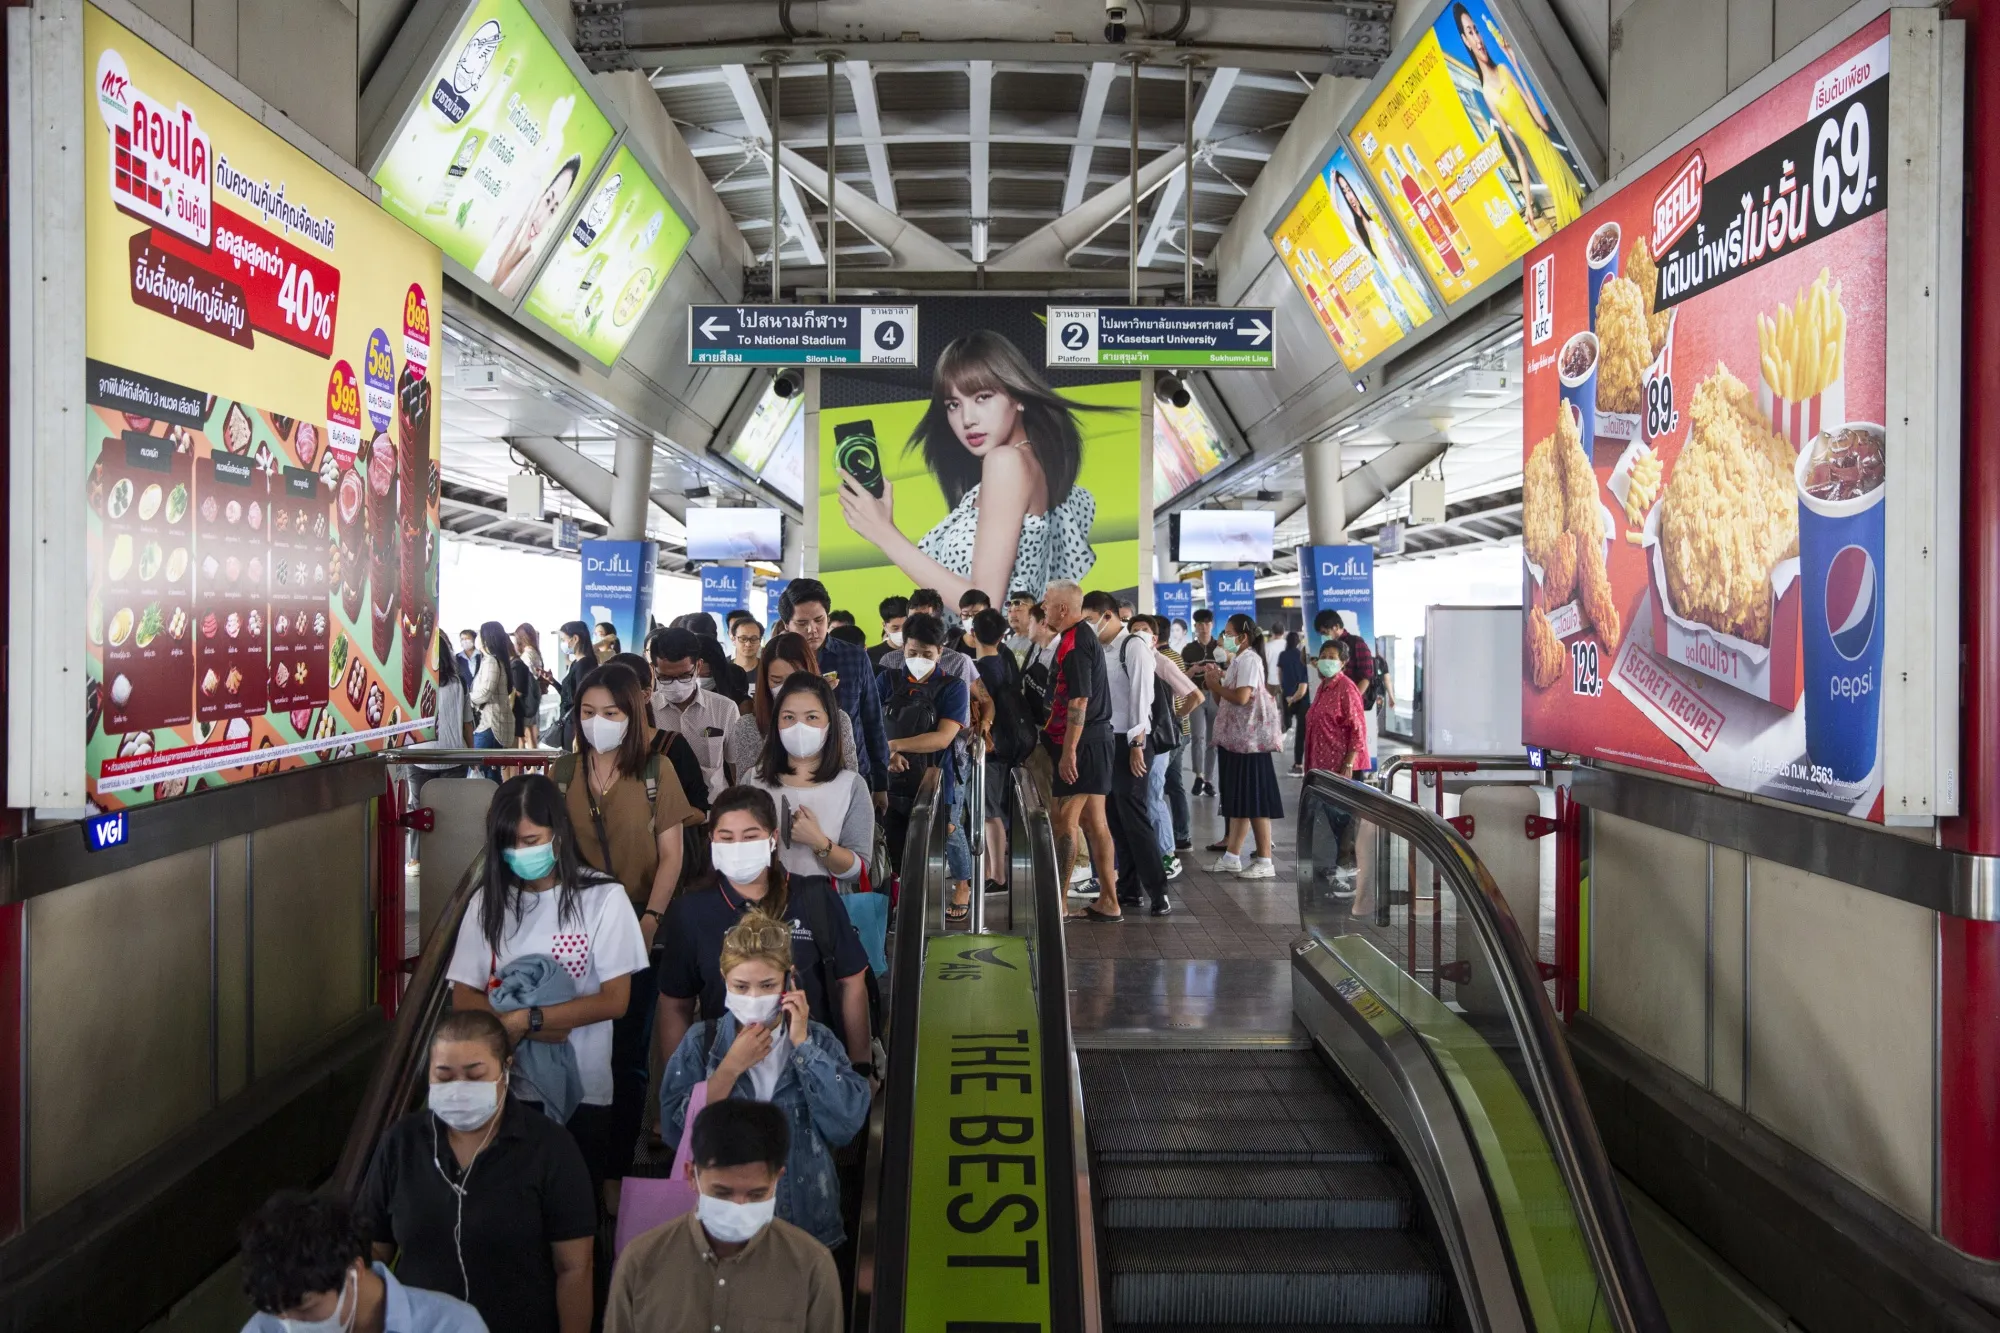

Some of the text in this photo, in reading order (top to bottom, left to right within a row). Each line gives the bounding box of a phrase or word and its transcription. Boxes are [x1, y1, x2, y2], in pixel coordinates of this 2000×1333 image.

[101, 70, 128, 105] MK
[1815, 62, 1871, 111] เริ่มต้นเพียง
[133, 100, 206, 185] คอนโด
[216, 156, 335, 249] กับความคุ้มที่คุณจัดเองได้
[1656, 169, 1701, 243] REFILL
[215, 226, 284, 279] ลดสูงสุดกว่า
[135, 248, 245, 337] ยิ่งสั่งชุดใหญ่ยิ่งคุ้ม
[737, 308, 848, 329] ไปสนามกีฬาฯ
[1055, 310, 1097, 319] ชานชาลา
[1101, 315, 1235, 331] ไปมหาวิทยาลัยเกษตรศาสตร์
[737, 335, 847, 345] To National Stadium
[882, 326, 896, 345] 4
[1066, 325, 1083, 348] 2
[1101, 334, 1217, 346] To Kasetsart University
[1534, 318, 1549, 340] KFC
[698, 350, 742, 363] สายสีลม
[805, 355, 846, 363] Silom Line
[871, 355, 906, 364] Platform
[1102, 351, 1149, 365] สายสุขุมวิท
[1209, 354, 1269, 363] Sukhumvit Line
[153, 394, 159, 406] 3
[159, 395, 177, 412] หมวด
[178, 398, 200, 418] เลือกได้
[1625, 425, 1630, 436] 2
[1731, 652, 1738, 679] 1
[1626, 651, 1716, 740] SECRET RECIPE
[1830, 665, 1874, 703] pepsi
[1779, 760, 1790, 777] 26
[1791, 763, 1809, 781] ก.พ.
[1810, 764, 1833, 785] 2563
[938, 962, 982, 981] AIS
[950, 1029, 1032, 1095] THE
[946, 1114, 1040, 1285] BEST
